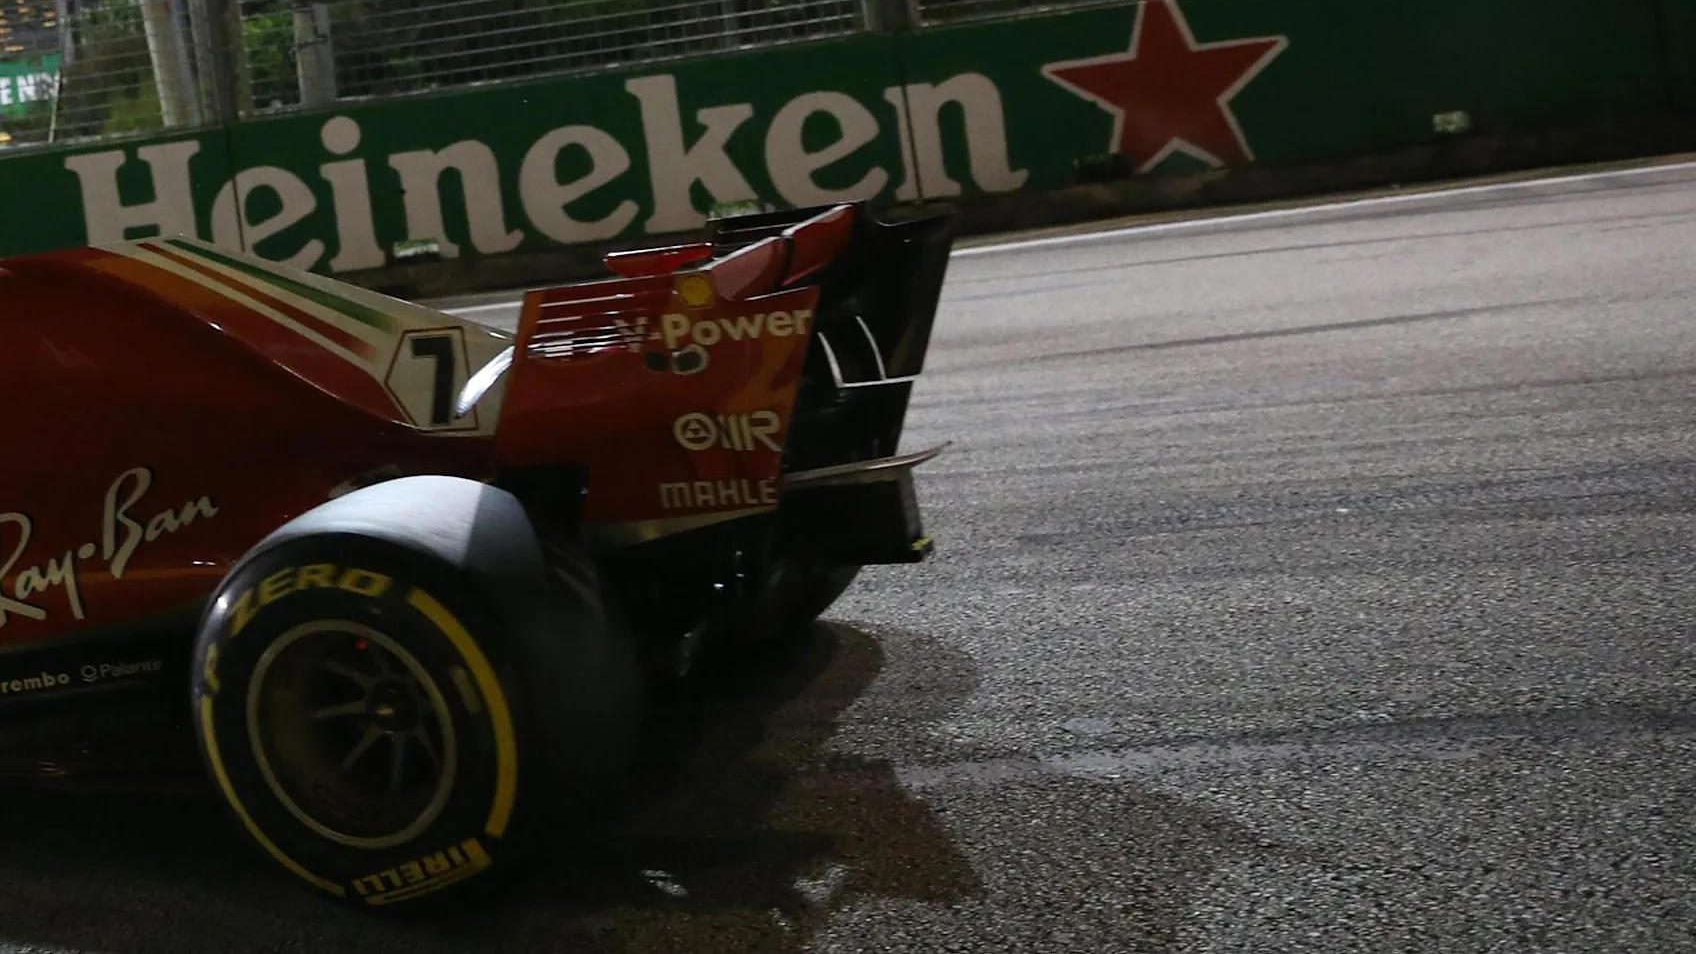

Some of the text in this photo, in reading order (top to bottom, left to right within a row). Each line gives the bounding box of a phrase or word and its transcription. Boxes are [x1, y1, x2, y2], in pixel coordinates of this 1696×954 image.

[64, 72, 1030, 275] Heineken
[408, 334, 455, 425] 7
[659, 477, 779, 510] MAHLE
[352, 836, 493, 907] PIRELLI
